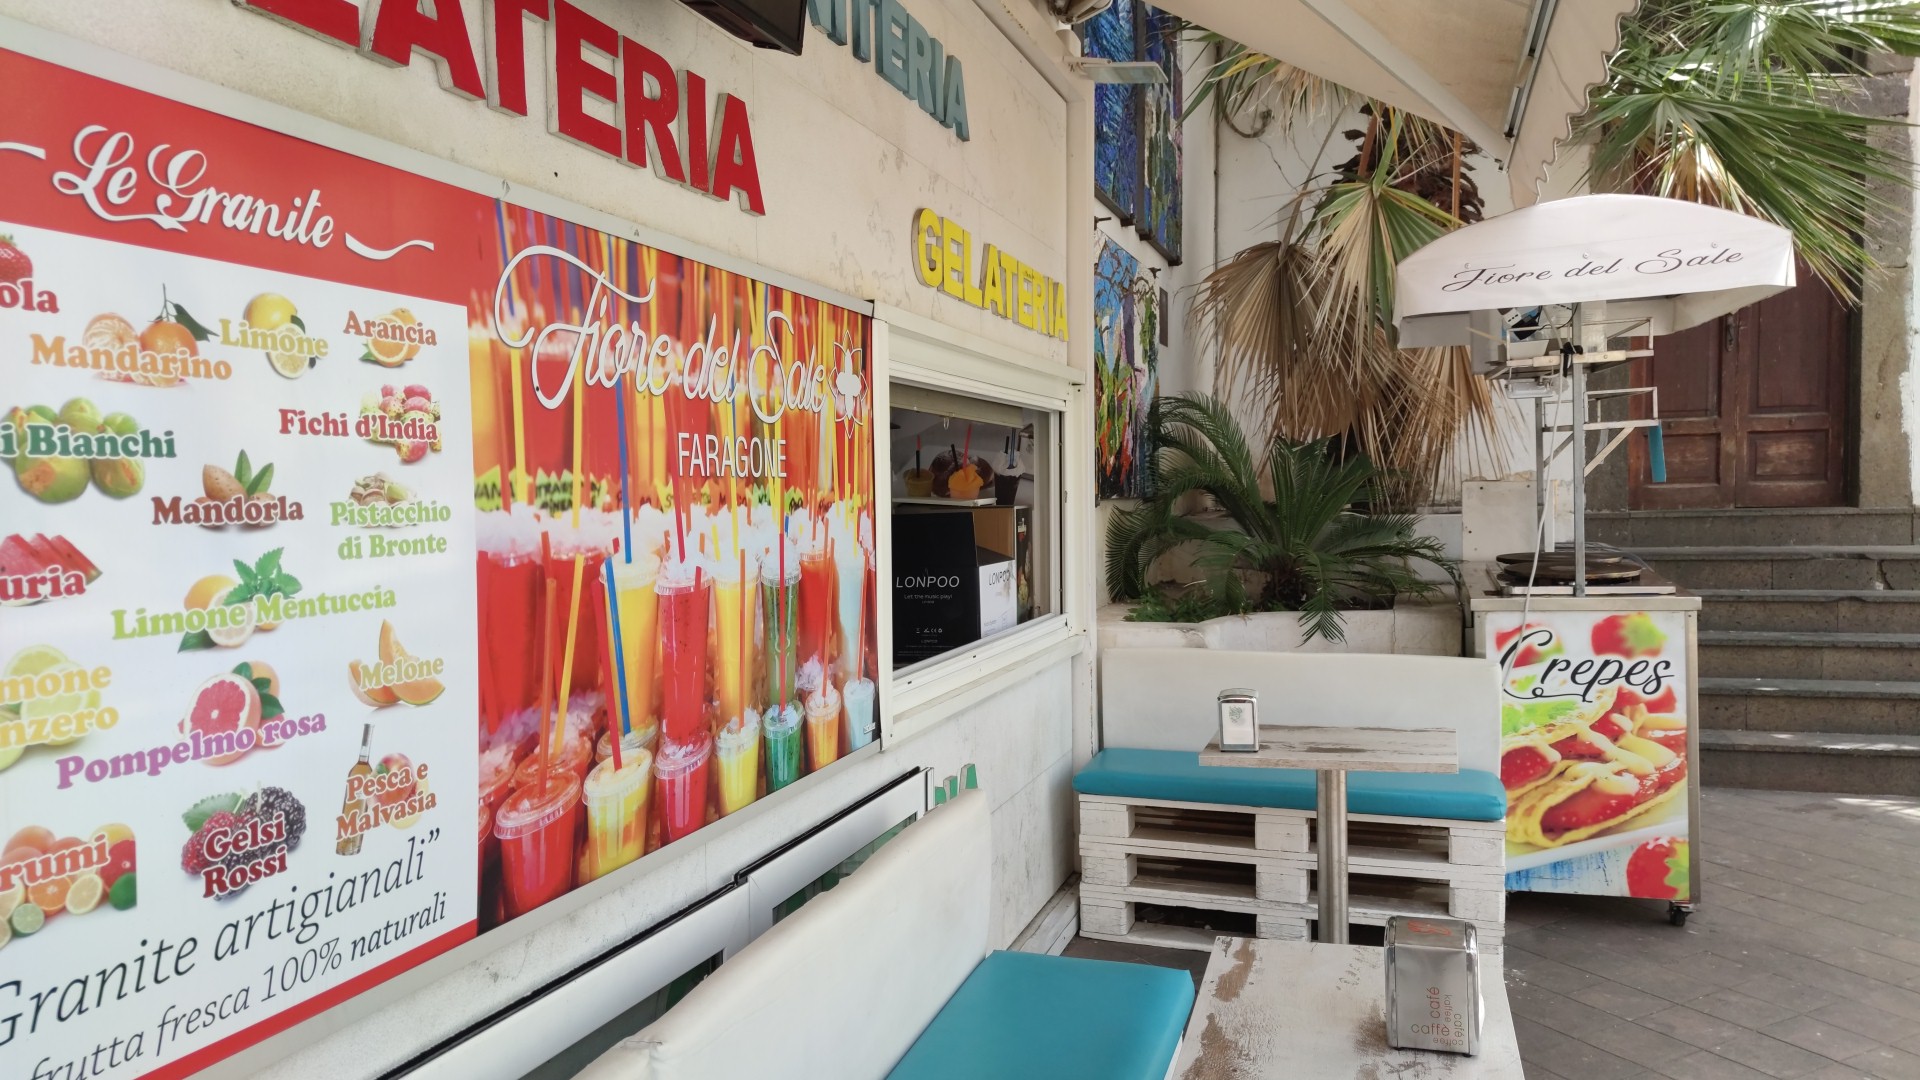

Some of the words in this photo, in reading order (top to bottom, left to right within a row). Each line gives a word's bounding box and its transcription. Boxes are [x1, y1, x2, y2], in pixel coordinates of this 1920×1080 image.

[53, 125, 188, 232] Le
[147, 144, 334, 248] Granite
[912, 207, 1069, 341] GELATERIA
[1442, 264, 1552, 292] Fiore
[1565, 258, 1623, 276] del
[1635, 247, 1743, 274] Sale
[219, 319, 329, 357] Limone
[343, 311, 437, 346] Arancia
[495, 245, 671, 409] Fiore
[682, 312, 739, 403] del
[748, 311, 827, 424] Sale
[30, 333, 232, 381] Mandarino
[27, 424, 176, 458] Bianchi
[279, 408, 349, 438] Fichi
[678, 432, 787, 478] FARAGONE
[151, 495, 303, 525] Mandorla
[330, 501, 451, 526] Pistacchio
[338, 537, 363, 560] di
[370, 534, 447, 558] Bronte
[896, 576, 960, 588] LONPOO
[112, 602, 246, 640] Limone
[254, 585, 396, 624] Mentuccia
[359, 657, 444, 691] Melone
[1500, 629, 1674, 703] Crepes
[55, 726, 254, 790] Pompelmo
[262, 713, 326, 745] rosa
[346, 767, 412, 802] Pesca
[417, 763, 428, 781] e
[204, 812, 286, 860] Gelsi
[335, 790, 437, 840] Malvasia
[202, 849, 288, 899] Rossi
[157, 986, 249, 1055] fresca
[260, 937, 342, 1002] 100%
[350, 893, 447, 961] naturali
